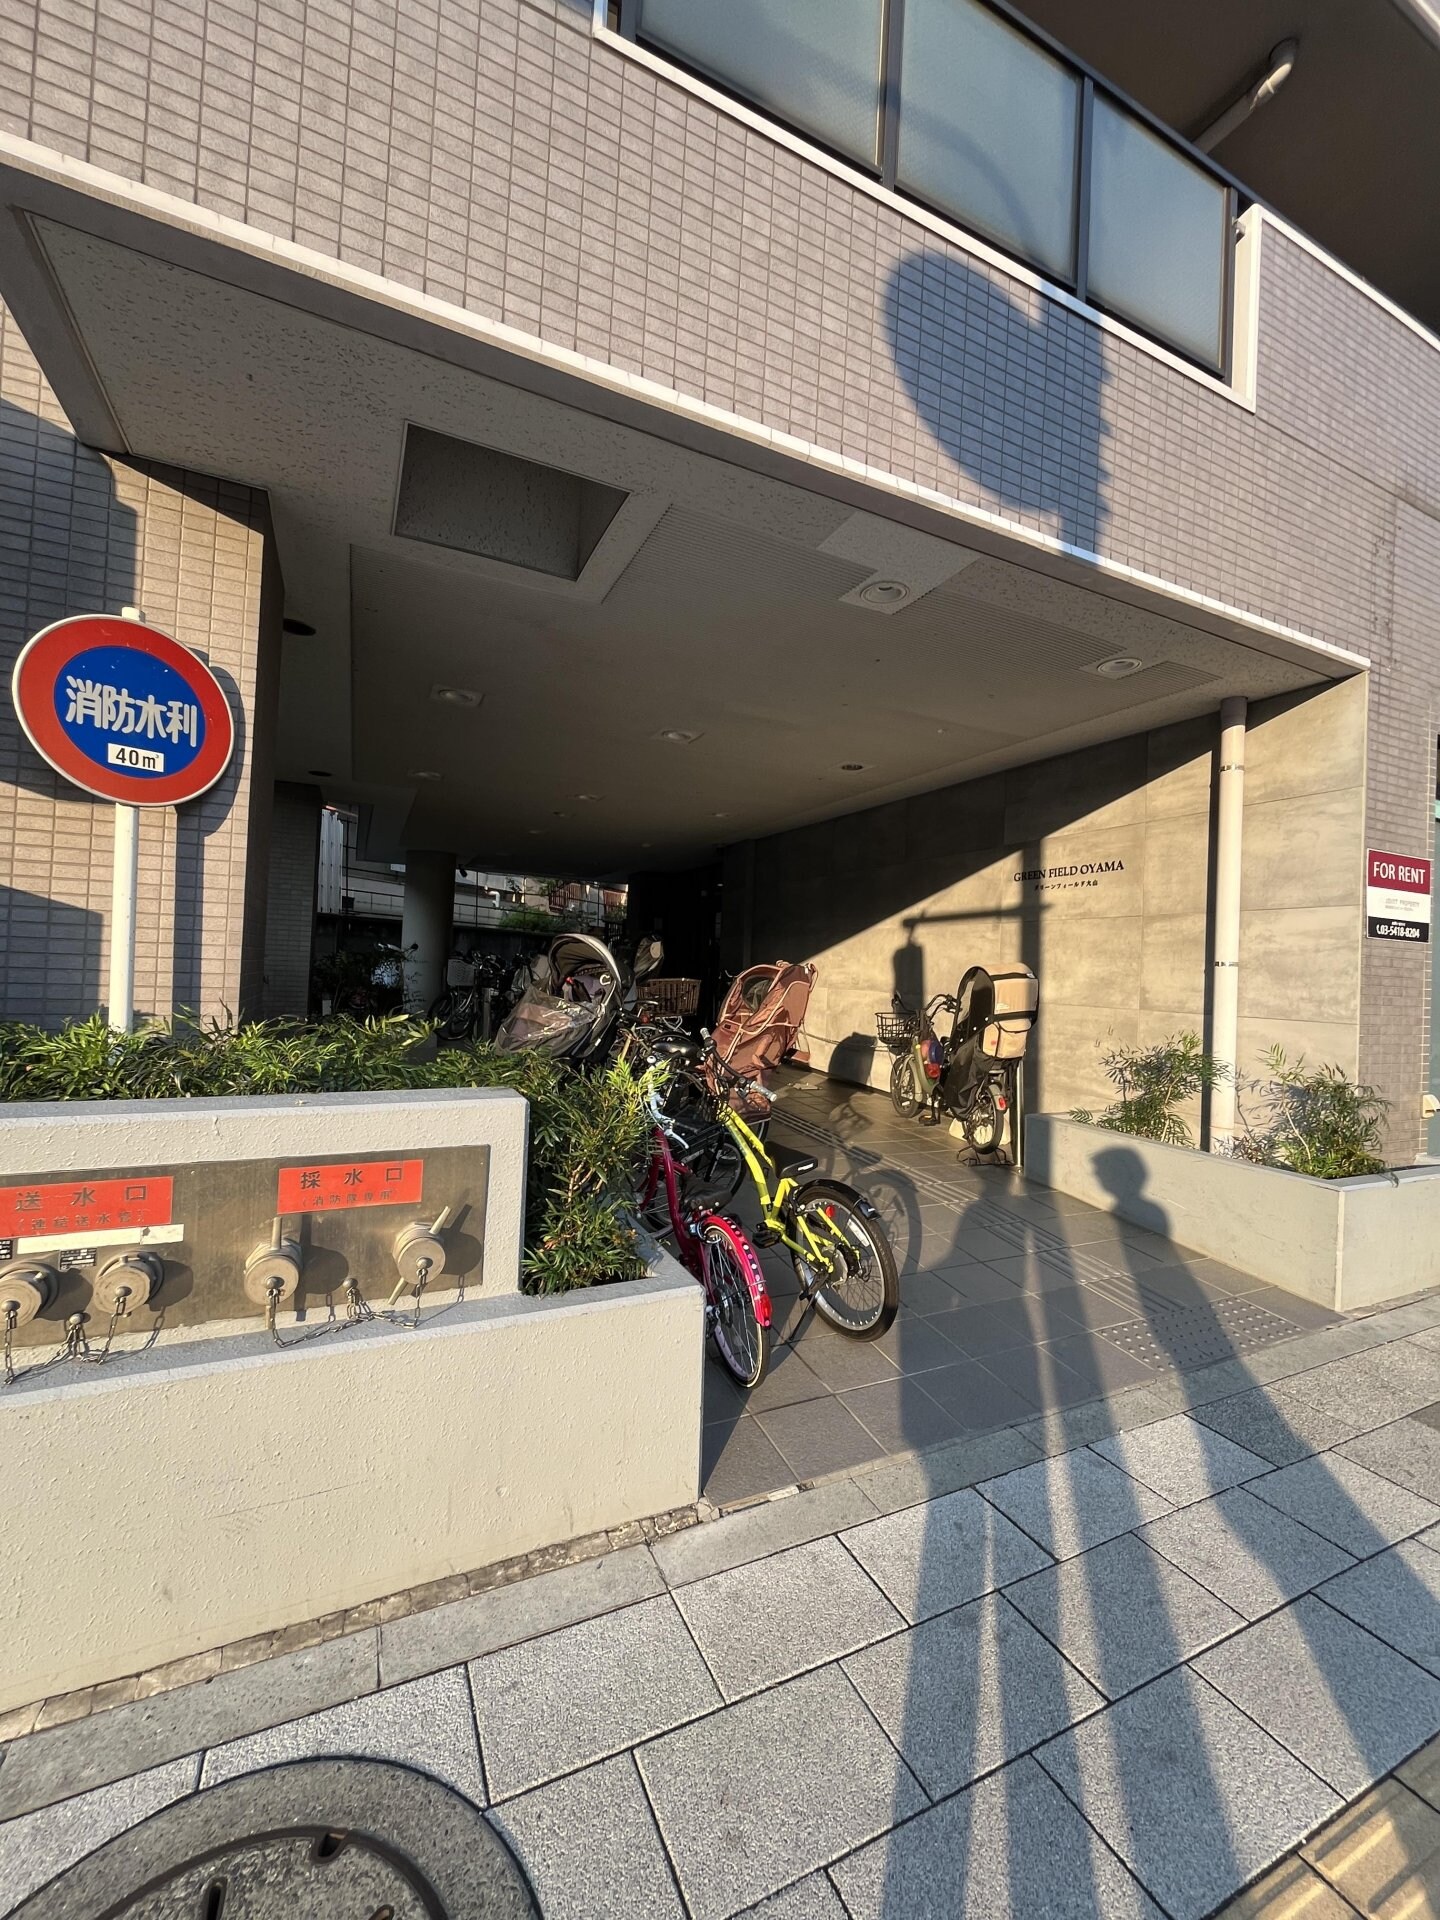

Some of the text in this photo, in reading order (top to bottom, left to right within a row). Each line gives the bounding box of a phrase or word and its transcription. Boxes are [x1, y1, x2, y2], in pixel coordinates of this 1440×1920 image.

[66, 676, 197, 747] 消防水利
[1014, 860, 1124, 881] GREEN FIELD OYAMA
[1373, 861, 1426, 884] FOR RENT
[300, 1167, 402, 1189] 採水口
[15, 1185, 147, 1212] 送水口
